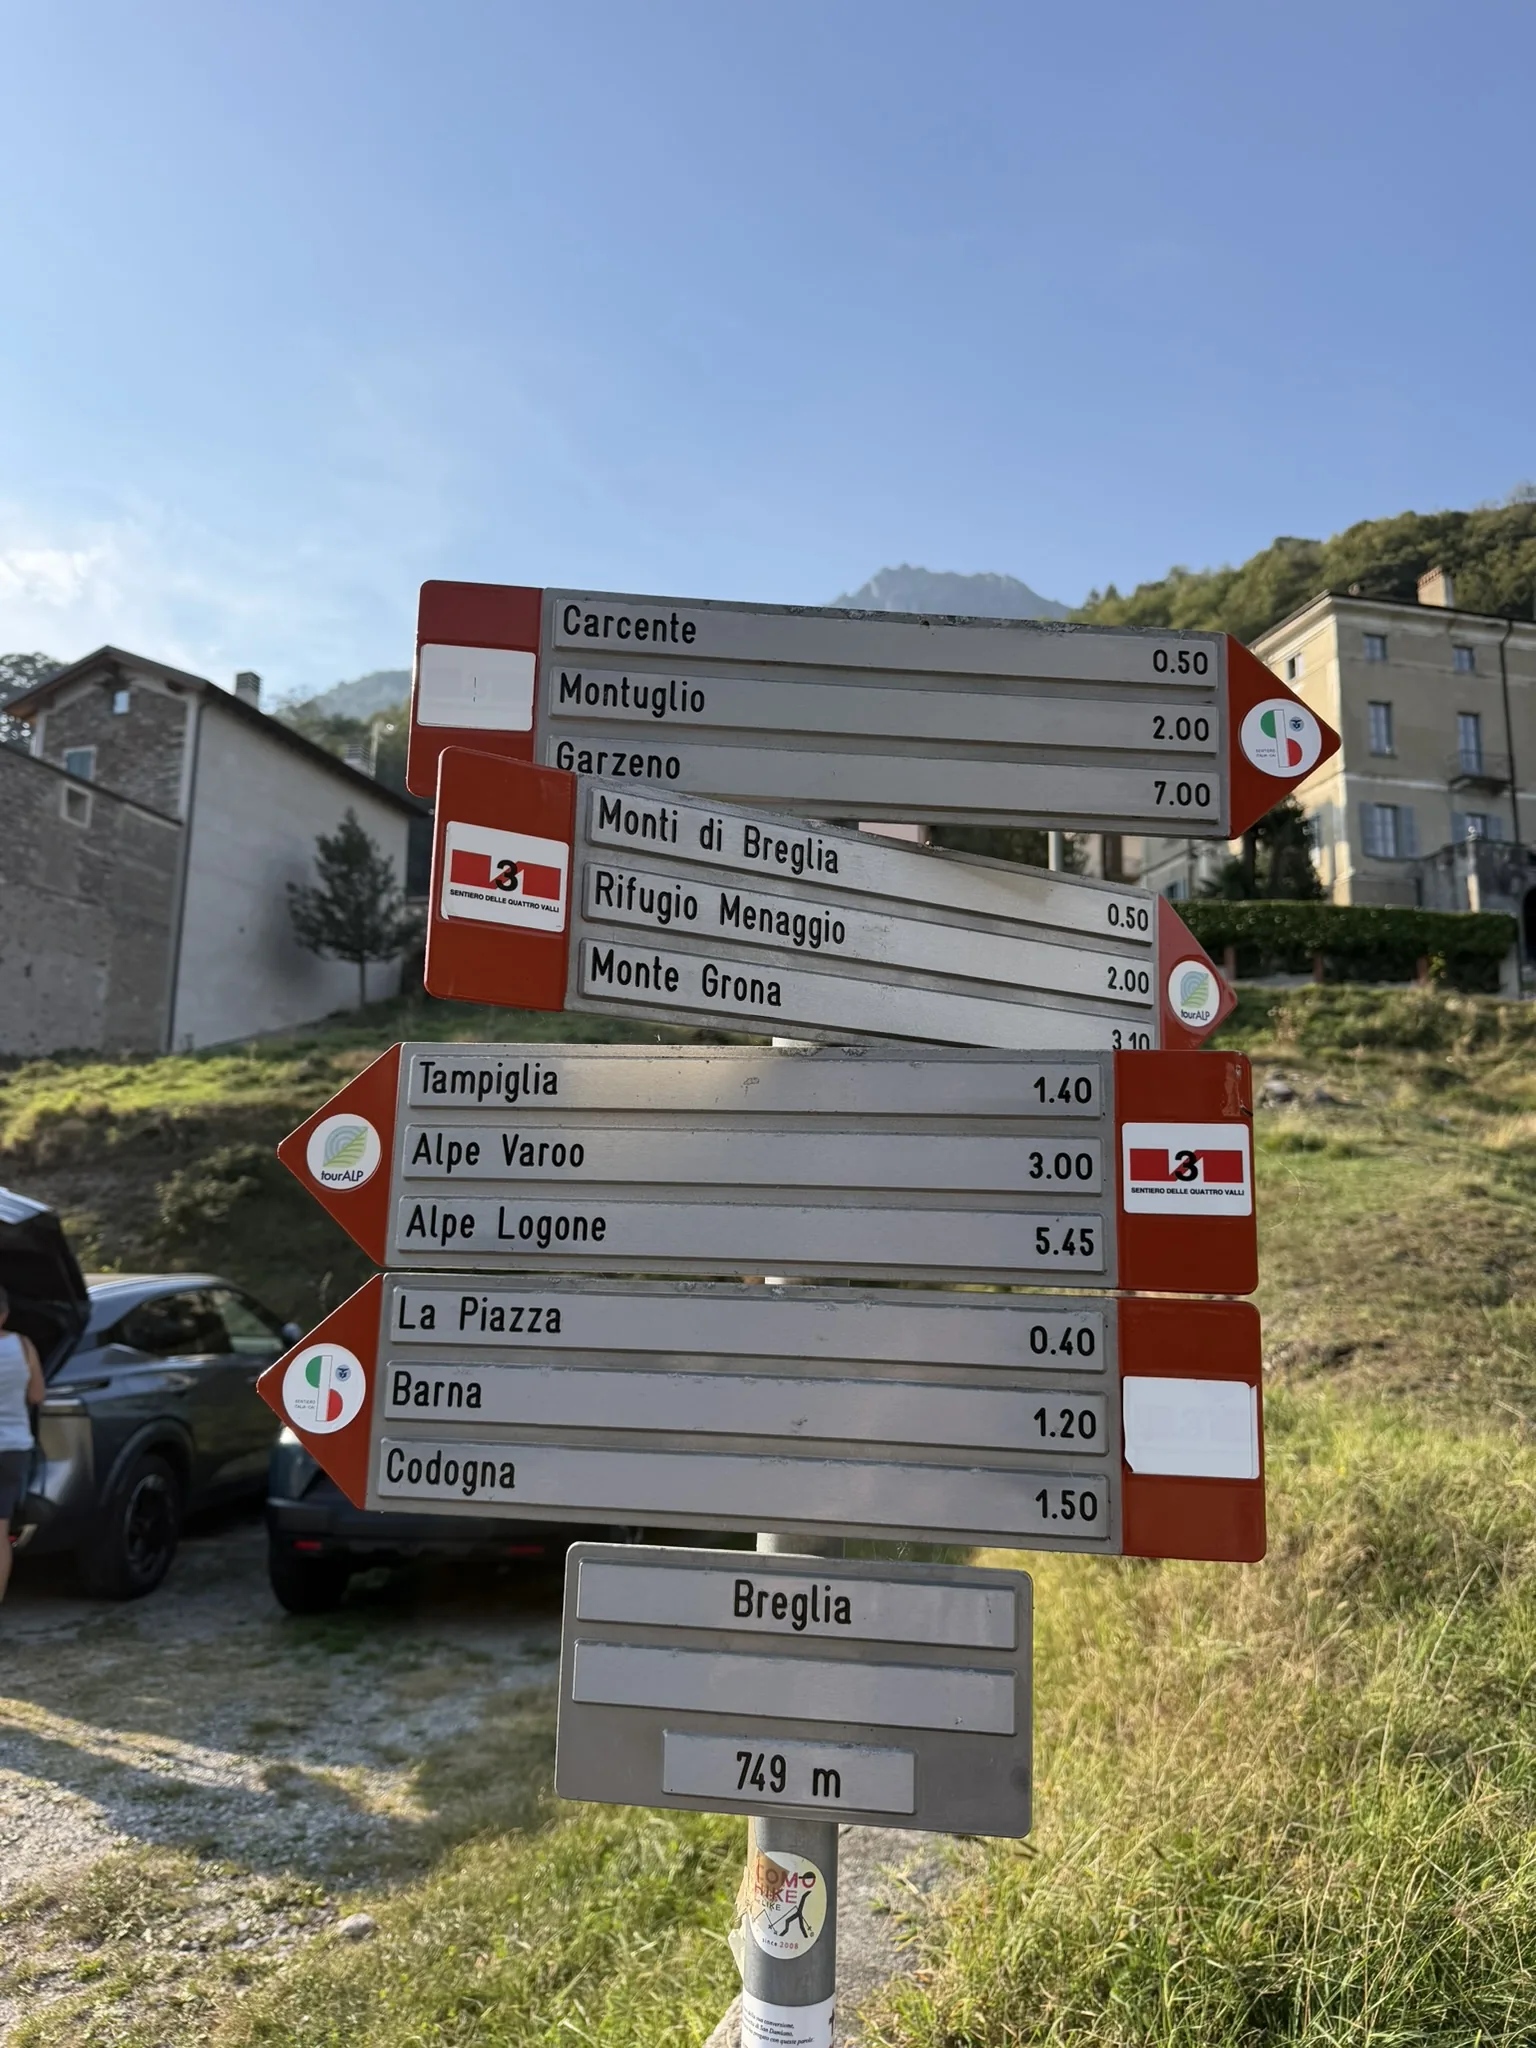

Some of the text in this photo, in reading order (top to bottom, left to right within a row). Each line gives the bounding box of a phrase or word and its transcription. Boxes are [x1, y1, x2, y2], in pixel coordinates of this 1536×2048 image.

[562, 603, 697, 644] Carcente
[1153, 649, 1209, 676] 0.50
[559, 672, 705, 719] Montuglio
[1153, 715, 1210, 742] 2.00
[555, 741, 681, 779] Garzeno
[1154, 780, 1211, 807] 7.00
[598, 795, 839, 875] Monti di Breglia
[495, 859, 519, 892] 3
[449, 889, 560, 913] SENTIERO DELLE QUATTRO VALLI
[593, 870, 847, 949] Rifugio Menaggio
[1107, 903, 1149, 932] 0.50
[590, 946, 782, 1007] Monte Grona
[1107, 966, 1149, 994] 2.00
[1180, 1009, 1211, 1021] tourALP
[1112, 1029, 1150, 1050] 310
[419, 1061, 558, 1103] Tampiglia
[1033, 1076, 1092, 1104] 1.40
[411, 1132, 585, 1174] Alpe Varoo
[1028, 1151, 1093, 1181] 3.00
[1174, 1149, 1199, 1182] 3
[320, 1170, 364, 1182] tourALP
[1166, 1187, 1188, 1195] DELLE
[1189, 1188, 1223, 1196] QUATTRO
[405, 1204, 607, 1249] Alpe Logone
[1035, 1226, 1094, 1257] 5.45
[398, 1295, 562, 1334] La Piazza
[1029, 1325, 1095, 1357] 0.40
[391, 1370, 482, 1409] Barna
[1033, 1407, 1097, 1440] 1.20
[386, 1447, 516, 1495] Codogna
[1034, 1488, 1098, 1522] 1.50
[733, 1579, 852, 1632] Breglia
[736, 1751, 841, 1799] 749 m
[762, 1937, 799, 1950] since 2008
